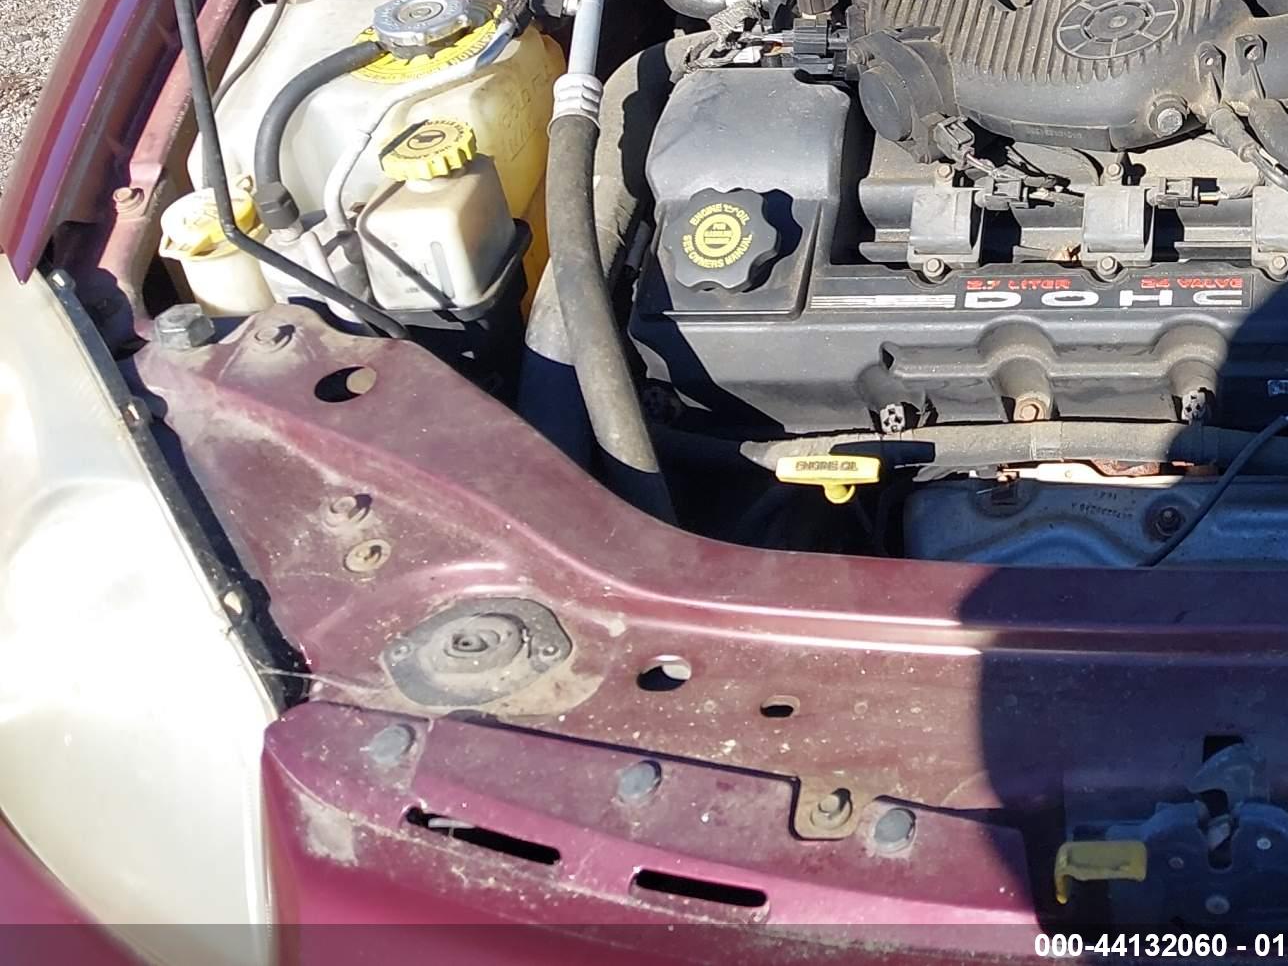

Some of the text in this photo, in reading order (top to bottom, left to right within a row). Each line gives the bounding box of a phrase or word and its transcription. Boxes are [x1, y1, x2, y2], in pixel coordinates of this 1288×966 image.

[736, 209, 750, 226] OIL
[966, 279, 1071, 290] 2.7 LITER
[1141, 278, 1243, 289] 24 VALVE
[964, 290, 1243, 309] DOHC
[795, 460, 858, 471] ENGINE OIL
